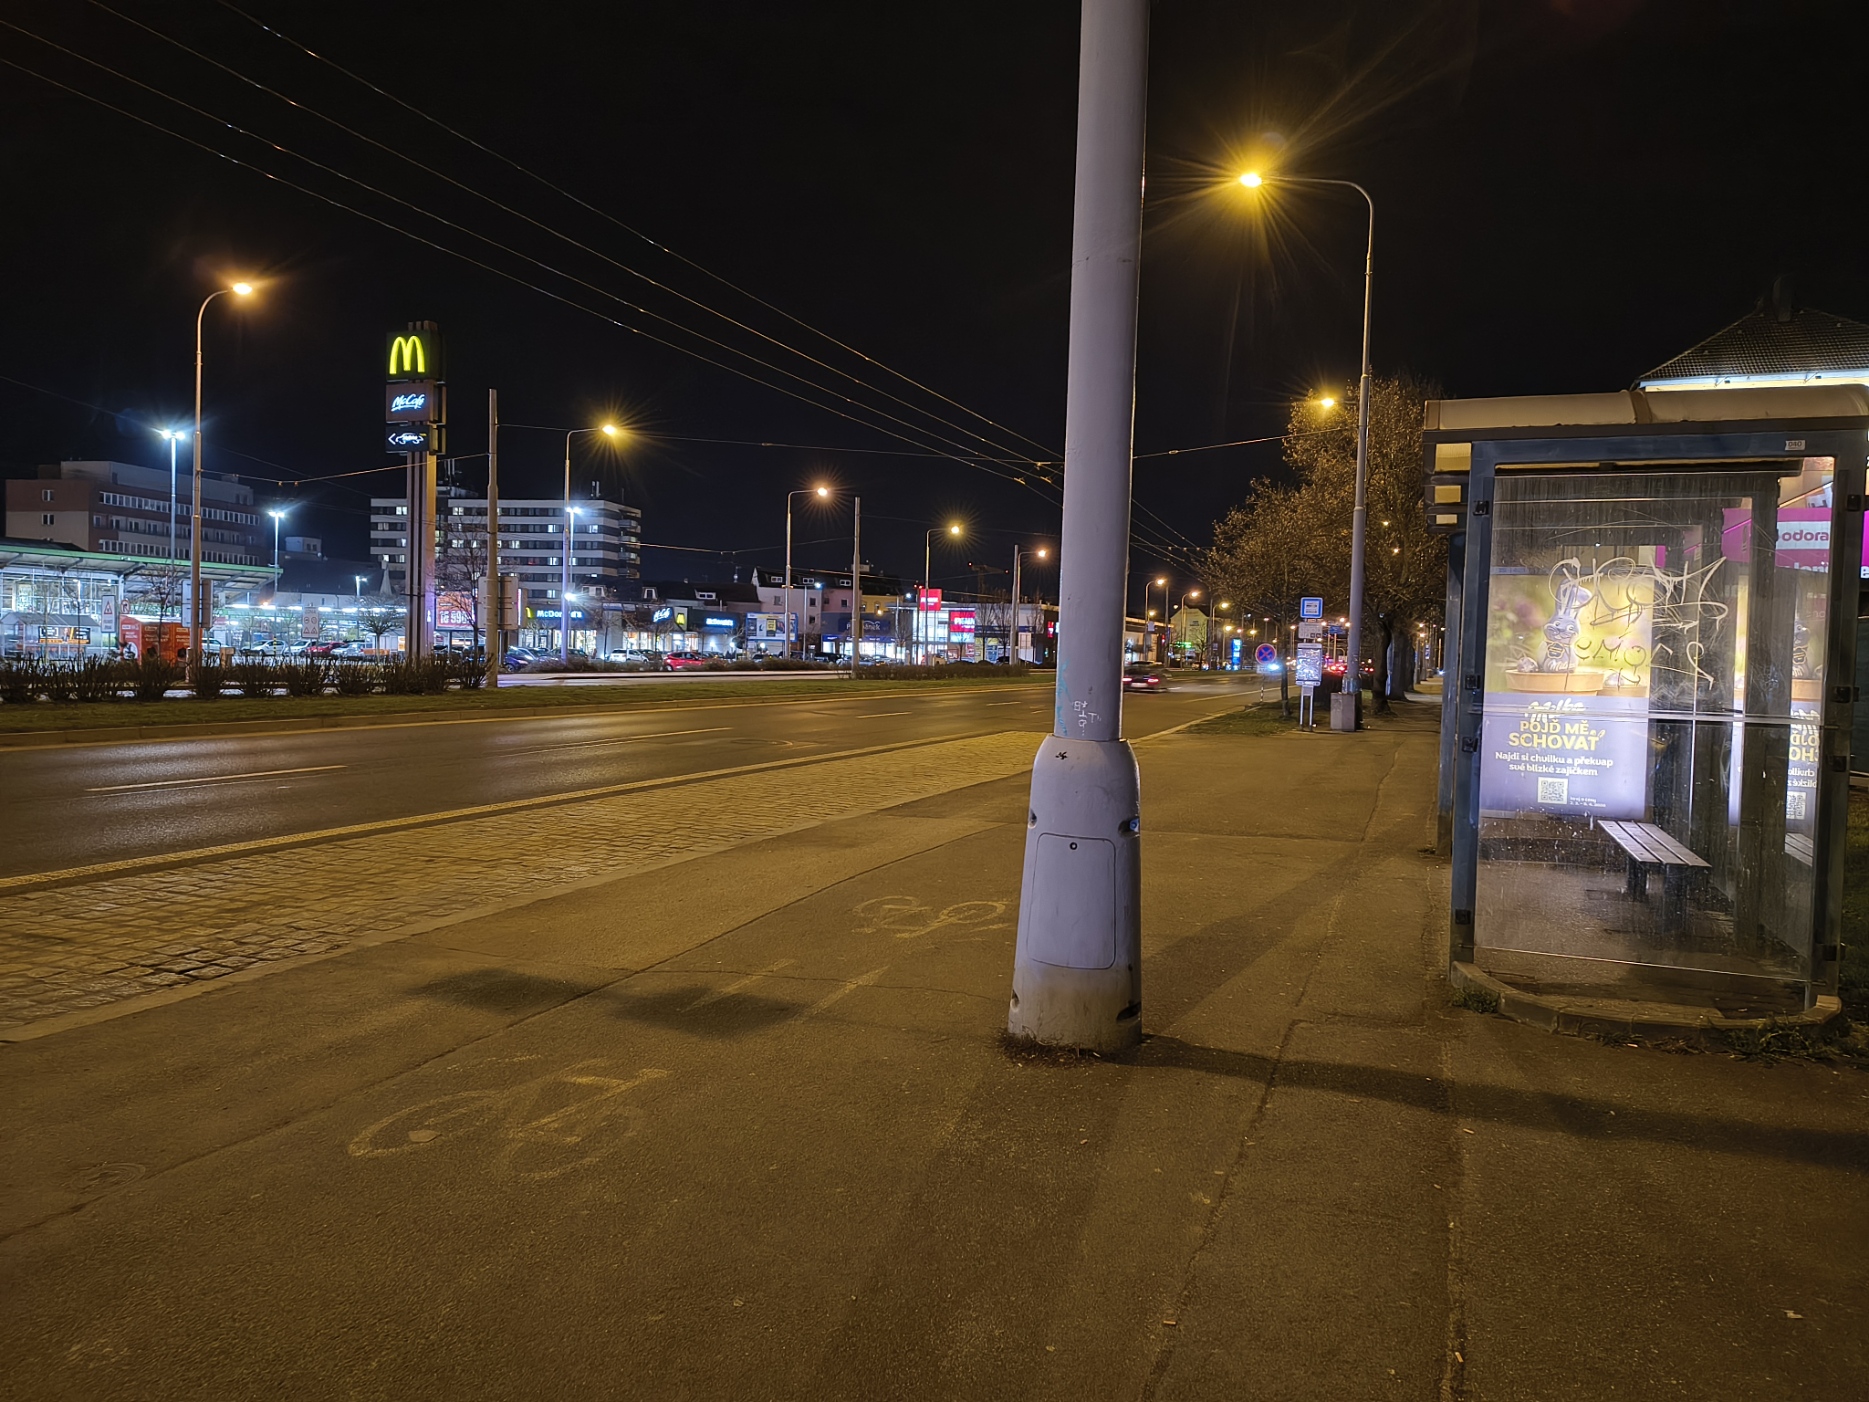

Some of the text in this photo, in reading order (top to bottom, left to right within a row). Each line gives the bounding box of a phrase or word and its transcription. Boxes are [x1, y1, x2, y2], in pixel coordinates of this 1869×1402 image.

[1565, 720, 1589, 735] MĚ
[1495, 751, 1520, 762] Najdi
[1521, 752, 1529, 762] si
[1509, 763, 1525, 772] své
